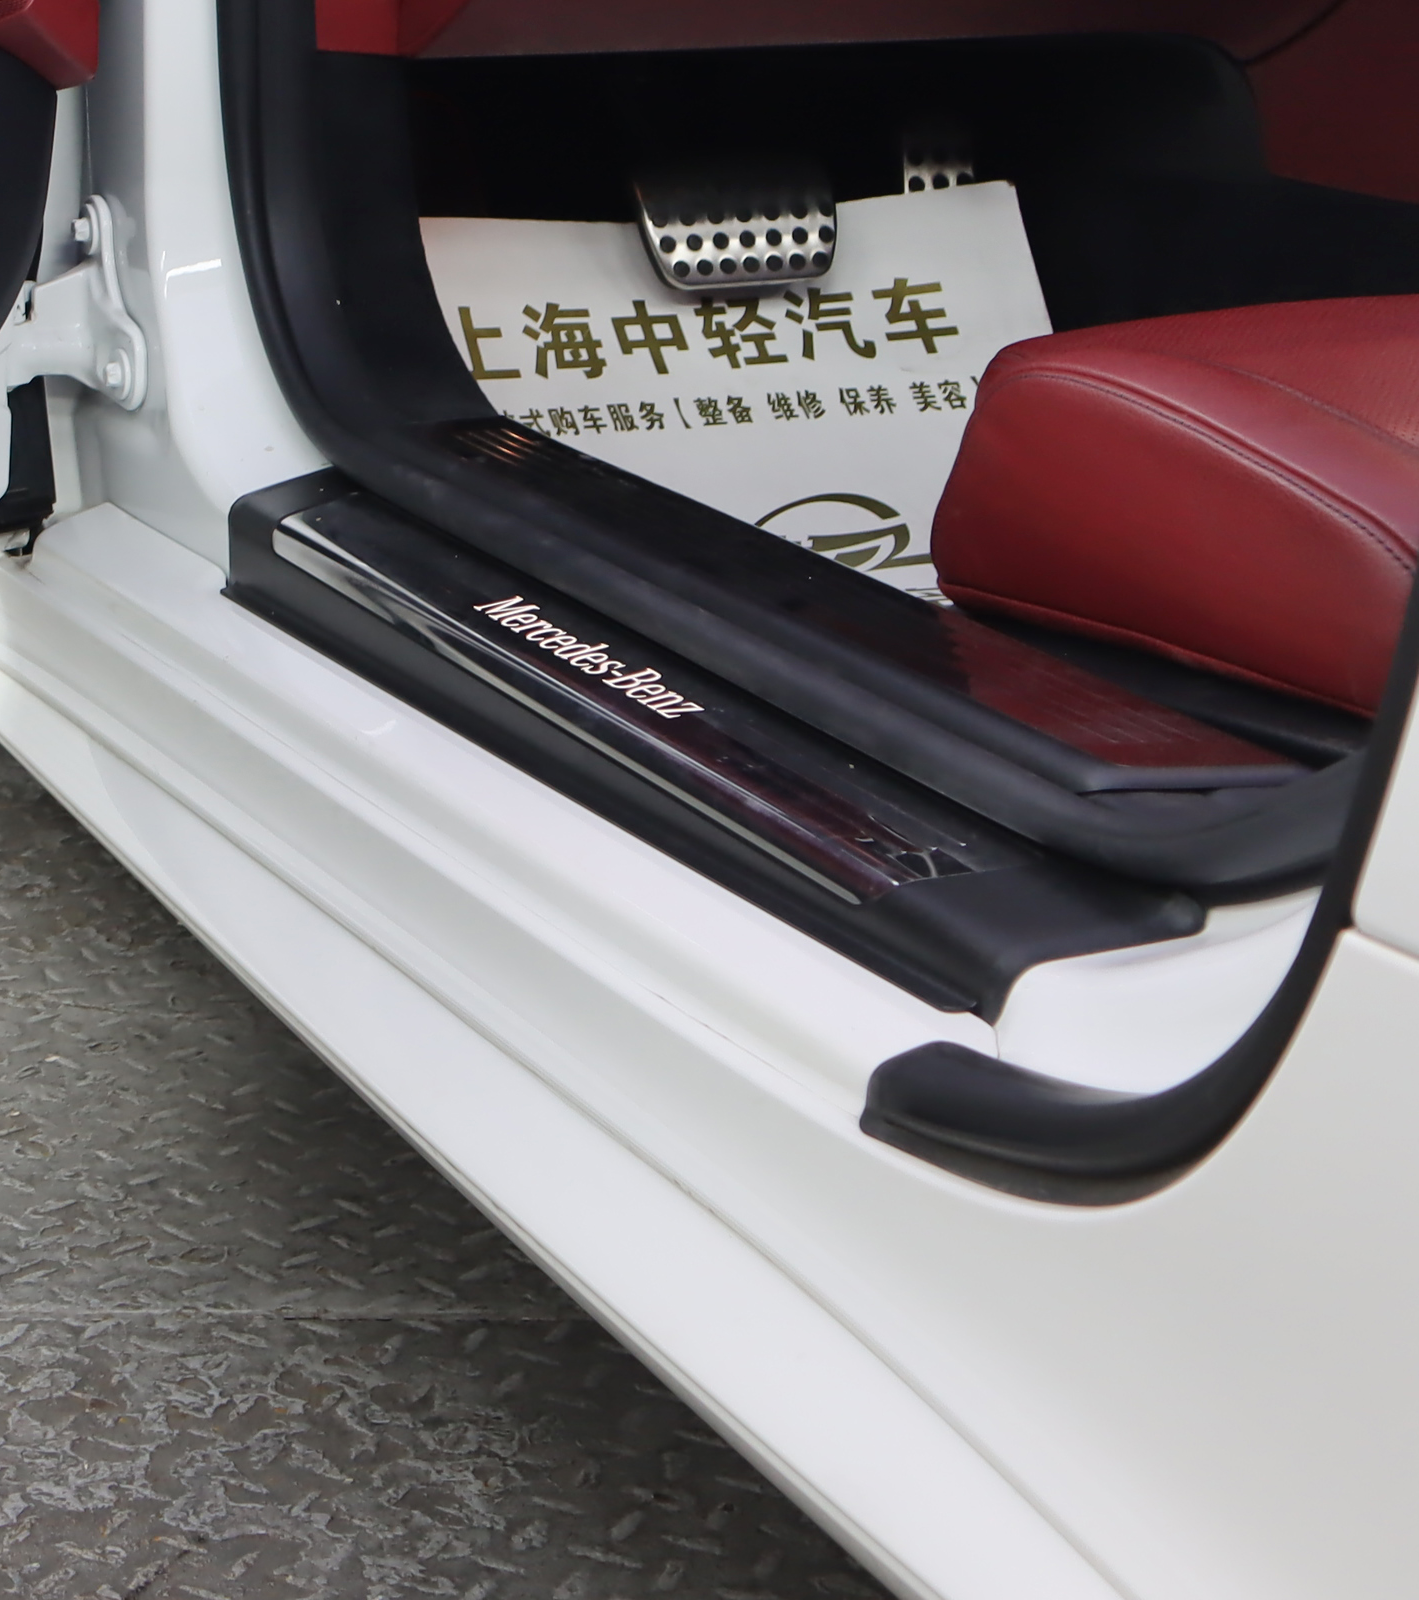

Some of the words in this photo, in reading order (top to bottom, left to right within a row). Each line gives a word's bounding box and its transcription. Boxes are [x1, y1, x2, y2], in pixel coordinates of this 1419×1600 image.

[458, 277, 959, 380] 上海中轻汽车
[766, 389, 826, 421] 维修
[838, 384, 898, 416] 保养
[473, 595, 705, 720] Mercedes-Benz
